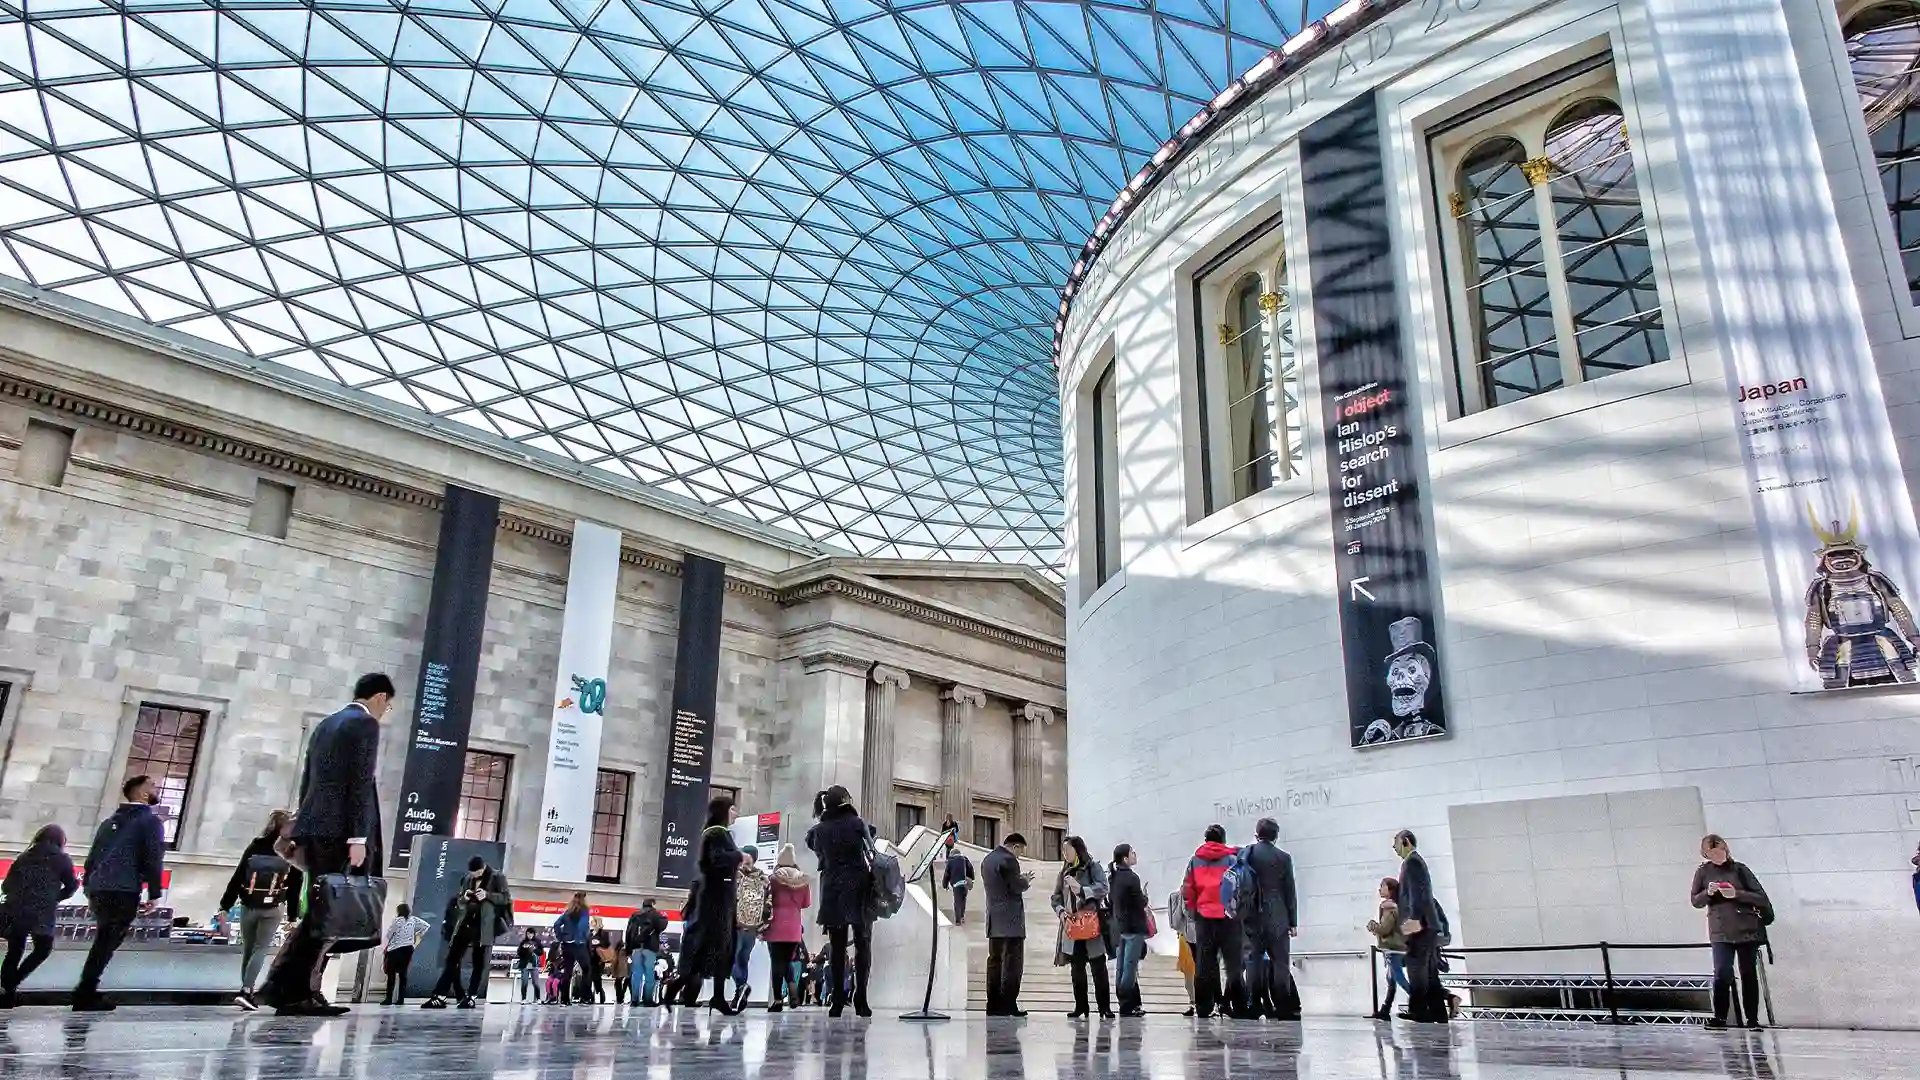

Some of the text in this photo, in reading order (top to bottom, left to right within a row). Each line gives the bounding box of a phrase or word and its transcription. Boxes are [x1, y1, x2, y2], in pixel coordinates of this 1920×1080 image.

[1118, 96, 1268, 260] ELIZABETH
[1329, 22, 1394, 89] AD
[1738, 376, 1808, 403] Japan
[1344, 389, 1392, 418] object
[1337, 420, 1360, 438] Ian
[1338, 424, 1397, 455] Hislop's
[1340, 445, 1389, 473] search
[1341, 473, 1363, 491] for
[1343, 478, 1399, 508] dissent
[1214, 785, 1331, 820] The Weston Family
[405, 807, 436, 821] Audio
[403, 821, 433, 833] guide
[545, 823, 574, 836] Family
[544, 835, 569, 846] guide
[666, 835, 689, 847] Audio
[665, 846, 687, 858] guide
